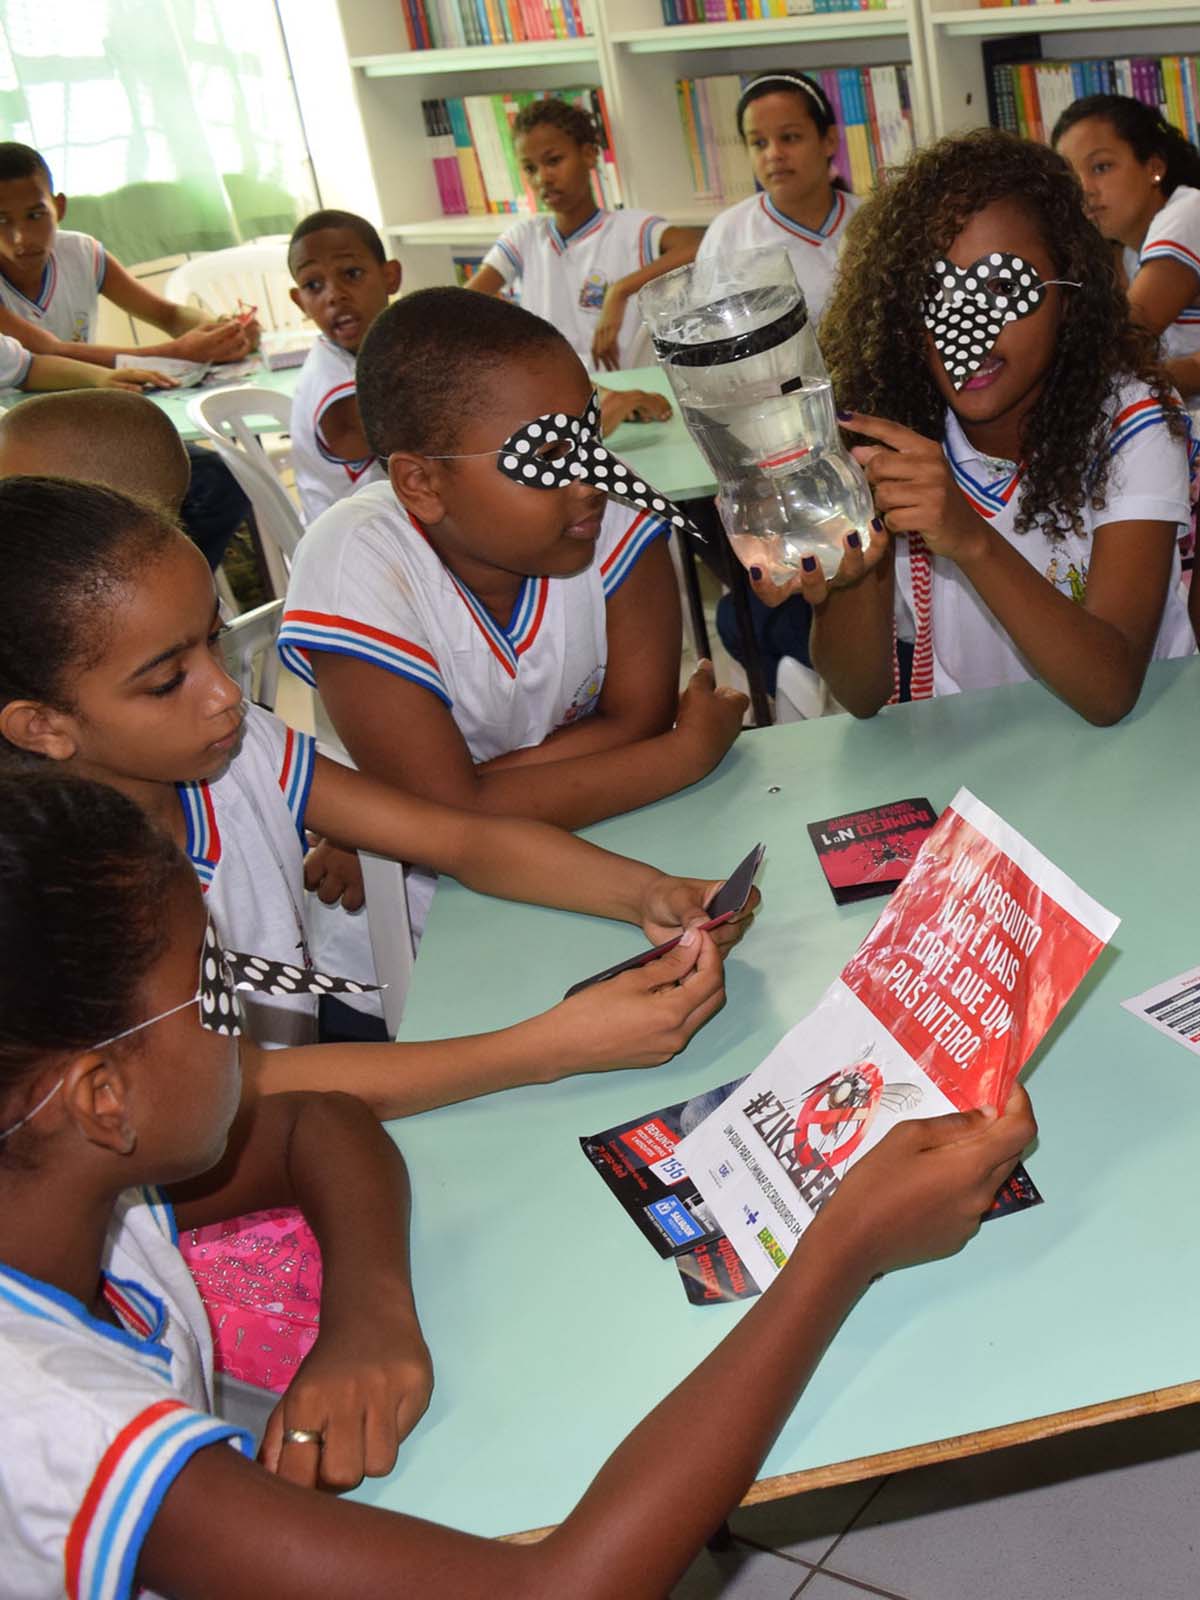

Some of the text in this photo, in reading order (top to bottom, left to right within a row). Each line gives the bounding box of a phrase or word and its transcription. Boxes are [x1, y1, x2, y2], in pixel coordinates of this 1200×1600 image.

[857, 810, 929, 836] INIMIGO
[936, 896, 1020, 992] NÃO É MAIS
[950, 852, 1042, 958] UM MOSQUITO
[882, 960, 982, 1069] PAÍS INTEIRO.
[906, 922, 1014, 1040] FORTE QUE UM
[660, 1158, 686, 1179] 156
[730, 1131, 742, 1150] GUIA
[738, 1143, 753, 1165] PARA
[749, 1157, 769, 1187] ELIMINAR
[761, 1181, 770, 1194] OS
[766, 1188, 798, 1230] CRIADOUROS
[791, 1221, 803, 1238] EM
[697, 1252, 721, 1298] Destrua
[757, 1227, 789, 1269] BRASIL
